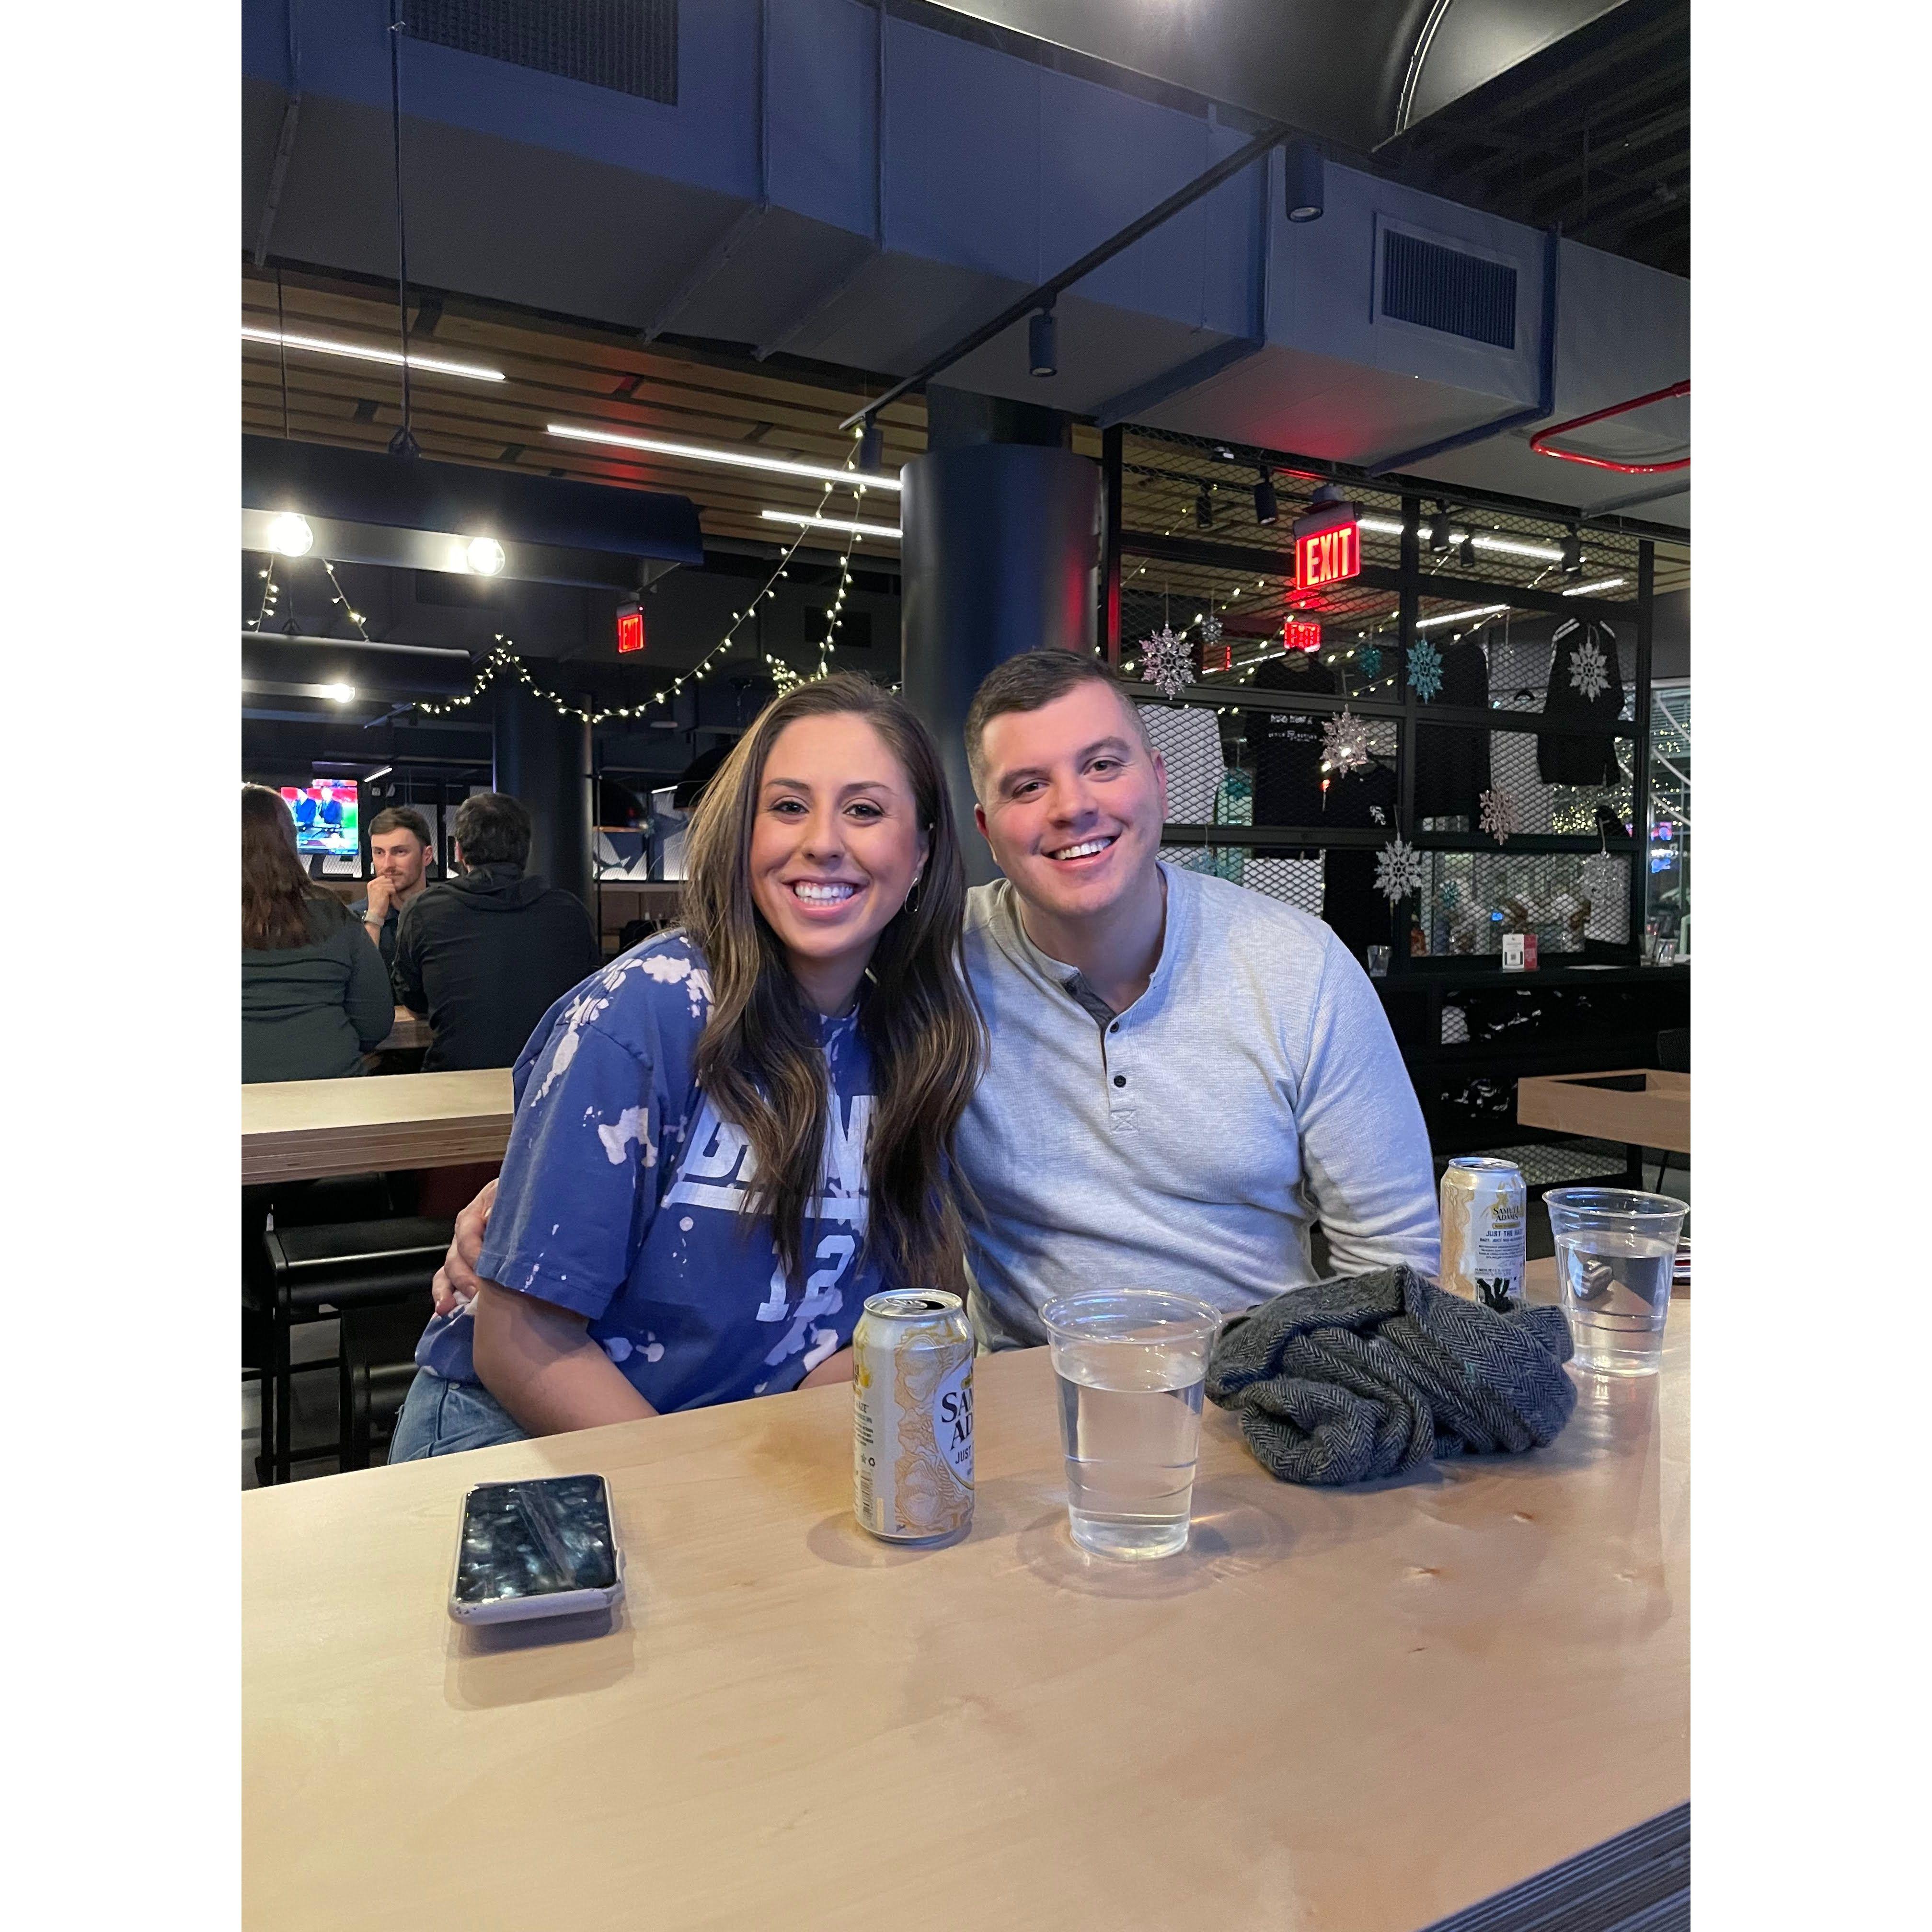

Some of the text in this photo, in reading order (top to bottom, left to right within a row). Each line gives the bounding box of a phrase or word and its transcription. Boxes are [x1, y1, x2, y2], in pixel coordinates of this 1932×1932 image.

[1307, 528, 1352, 585] EXIT
[623, 617, 639, 650] EXIT
[955, 1444, 971, 1464] JUST
